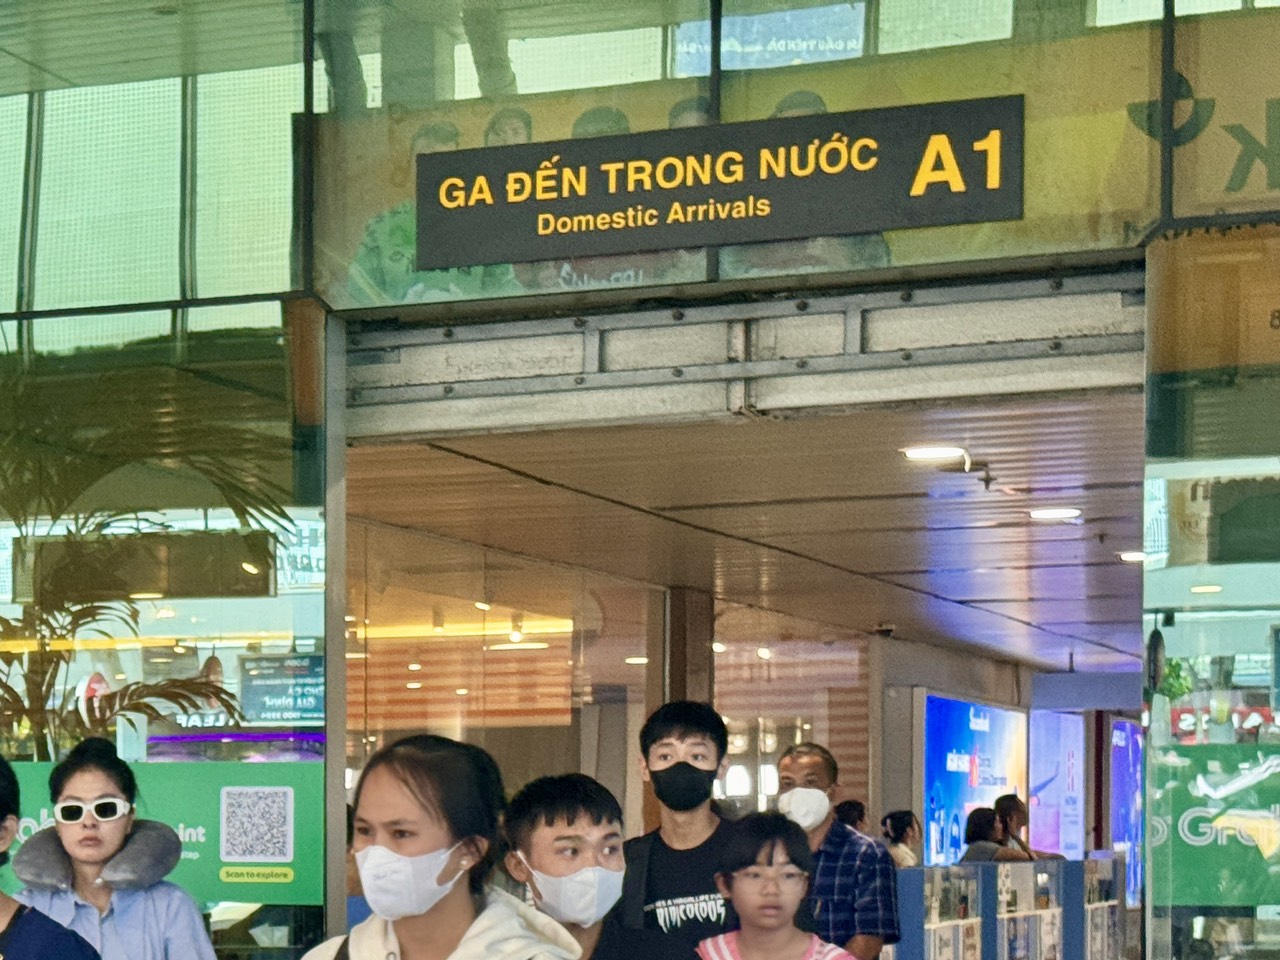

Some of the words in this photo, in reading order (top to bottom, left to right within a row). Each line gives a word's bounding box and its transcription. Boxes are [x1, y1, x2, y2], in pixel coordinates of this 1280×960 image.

[439, 175, 494, 210] GA
[505, 155, 588, 204] ĐẾN
[600, 151, 745, 194] TRONG
[758, 132, 879, 181] NƯỚC
[909, 128, 1003, 198] A1
[536, 203, 659, 237] Domestic
[666, 196, 772, 225] Arrivals
[177, 822, 206, 843] int
[225, 871, 245, 879] Scan
[246, 871, 255, 879] to
[255, 871, 289, 880] explore
